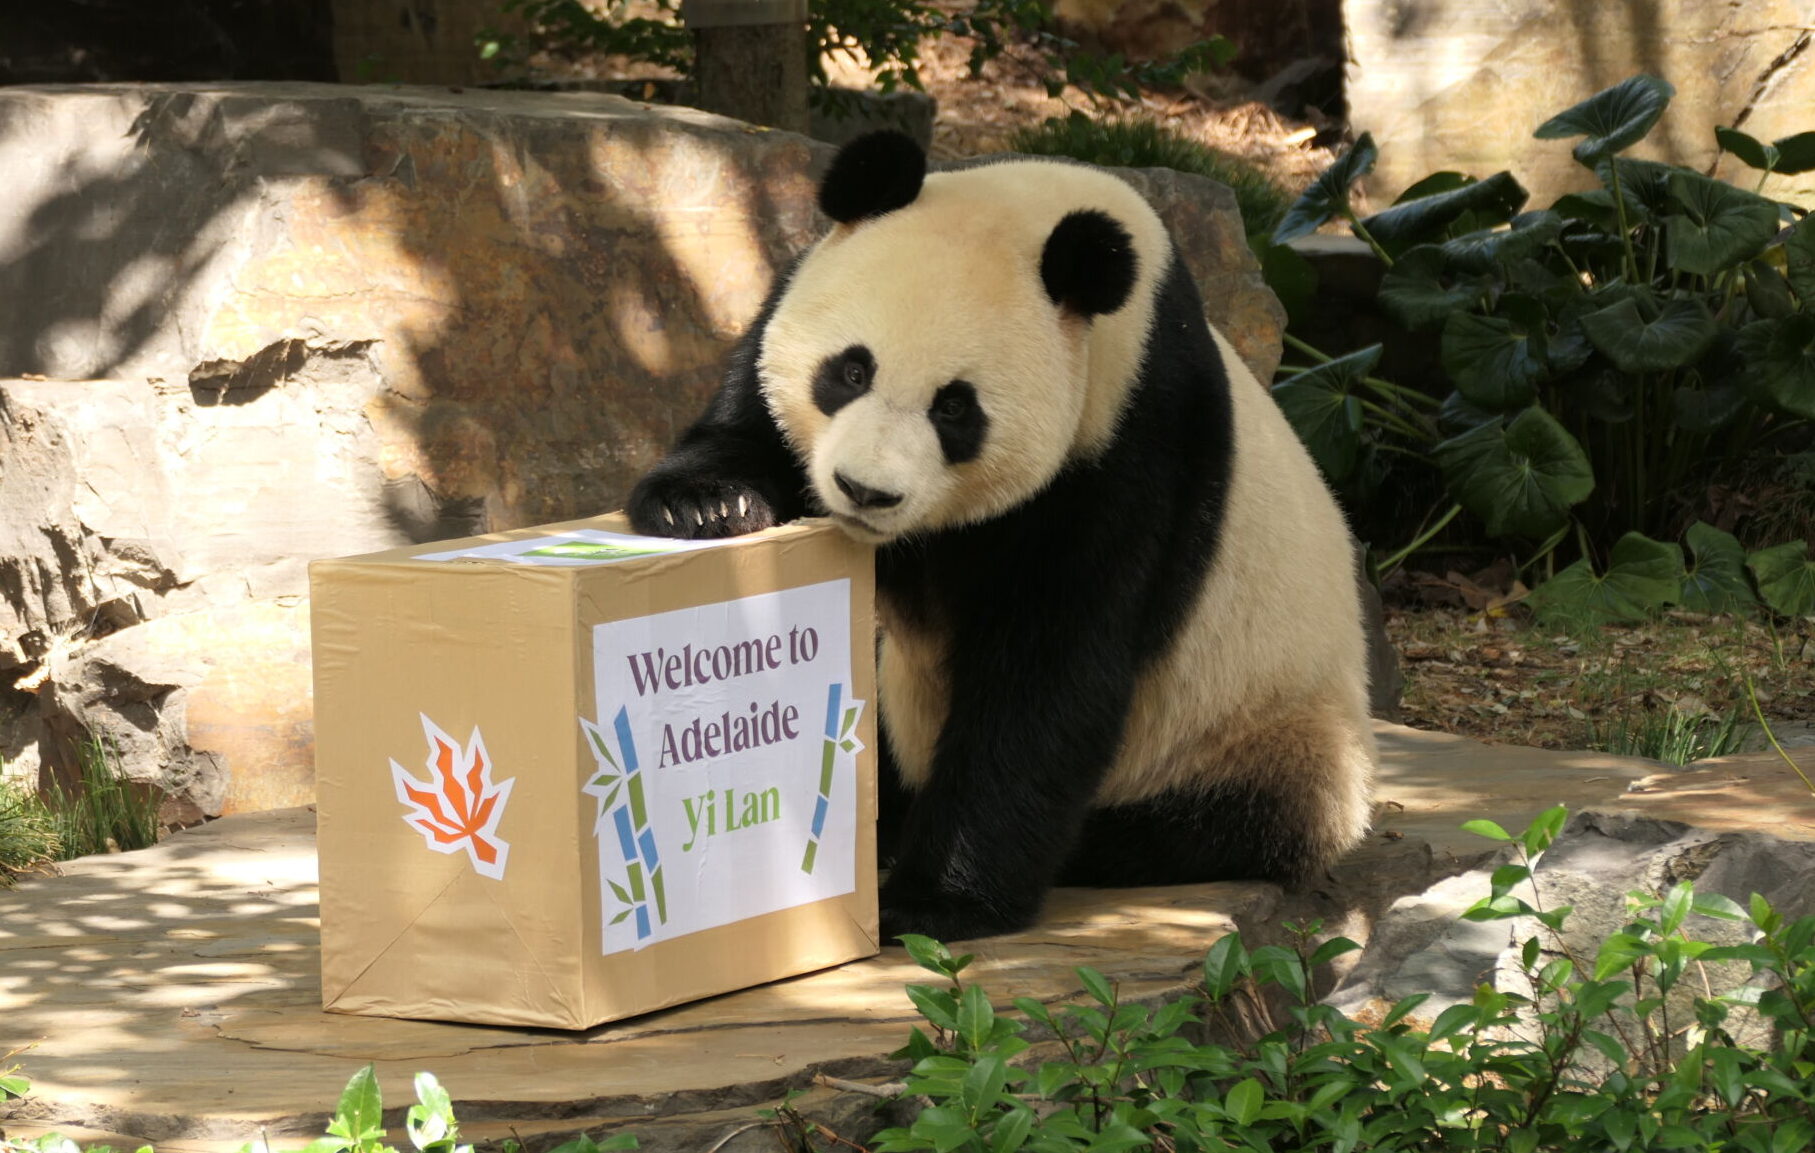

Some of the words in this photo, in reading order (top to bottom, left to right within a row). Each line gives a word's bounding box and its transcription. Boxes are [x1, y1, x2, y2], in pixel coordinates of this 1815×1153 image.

[627, 633, 782, 697] Welcome
[788, 623, 819, 666] to
[658, 699, 799, 769] Adelaide
[723, 786, 781, 833] Lan
